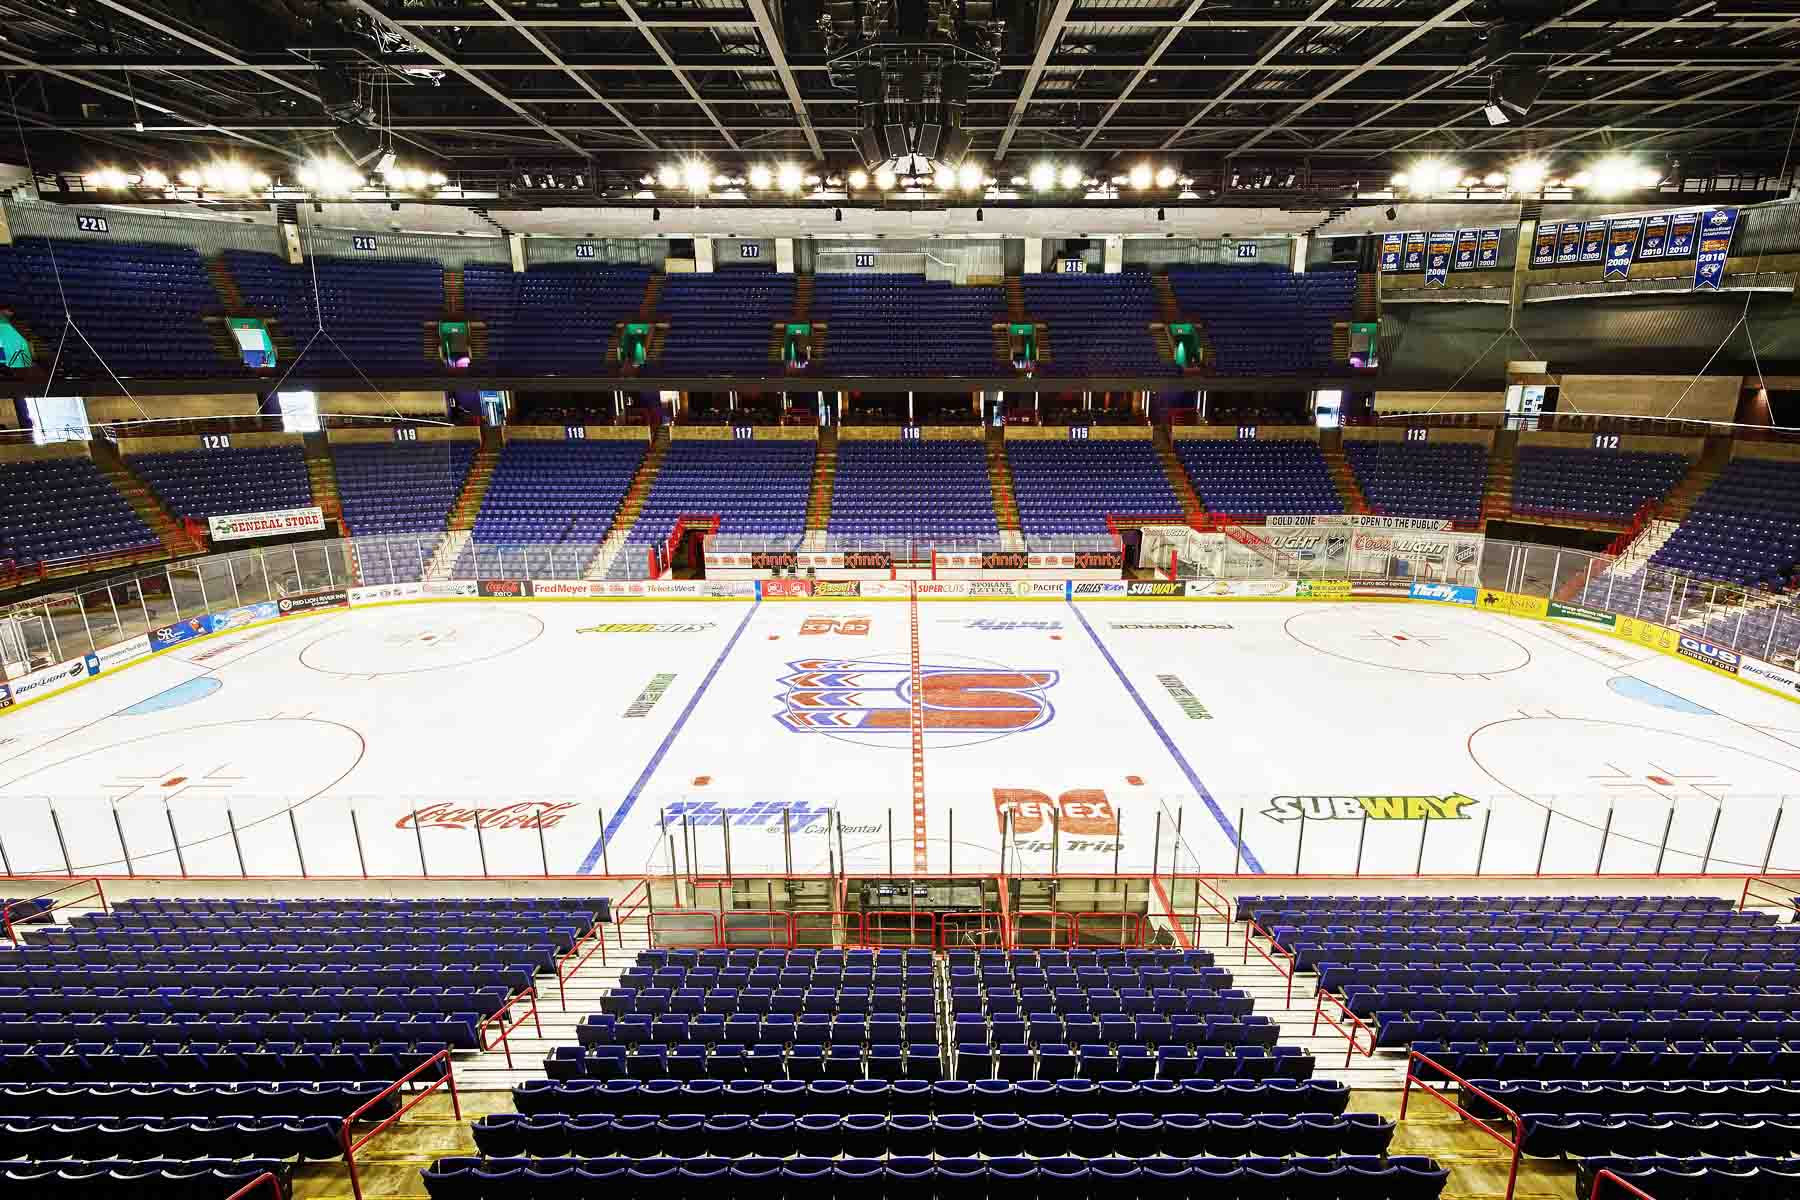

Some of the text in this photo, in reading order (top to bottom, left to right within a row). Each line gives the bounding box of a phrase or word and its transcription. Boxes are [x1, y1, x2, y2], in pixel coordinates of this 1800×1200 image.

[79, 216, 107, 231] 220
[356, 237, 375, 250] 219
[741, 246, 759, 257] 217
[1239, 245, 1256, 256] 214
[1642, 248, 1661, 256] 2010
[1669, 246, 1689, 254] 2010
[1607, 258, 1629, 266] 2009
[1699, 253, 1725, 262] 2010
[1066, 260, 1082, 271] 215
[397, 429, 416, 442] 119
[567, 427, 585, 439] 118
[735, 427, 753, 439] 117
[903, 427, 920, 439] 116
[1071, 427, 1088, 439] 115
[1239, 427, 1256, 439] 114
[1407, 429, 1427, 441] 113
[202, 435, 230, 449] 120
[1595, 436, 1618, 449] 112
[231, 519, 282, 532] GENERAL
[286, 515, 319, 526] STORE
[1272, 516, 1293, 525] COLD
[1295, 517, 1315, 525] ZONE
[1360, 517, 1439, 530] OPEN TO THE PUBLIC
[1074, 583, 1103, 593] EAGLES
[1127, 583, 1181, 594] SUBWAY
[1681, 638, 1736, 664] GUS
[1715, 662, 1735, 672] FORD
[1742, 664, 1761, 674] BUD
[16, 682, 37, 695] BUD
[1260, 792, 1480, 823] SUBWAY
[395, 802, 582, 829] Coca-Cola
